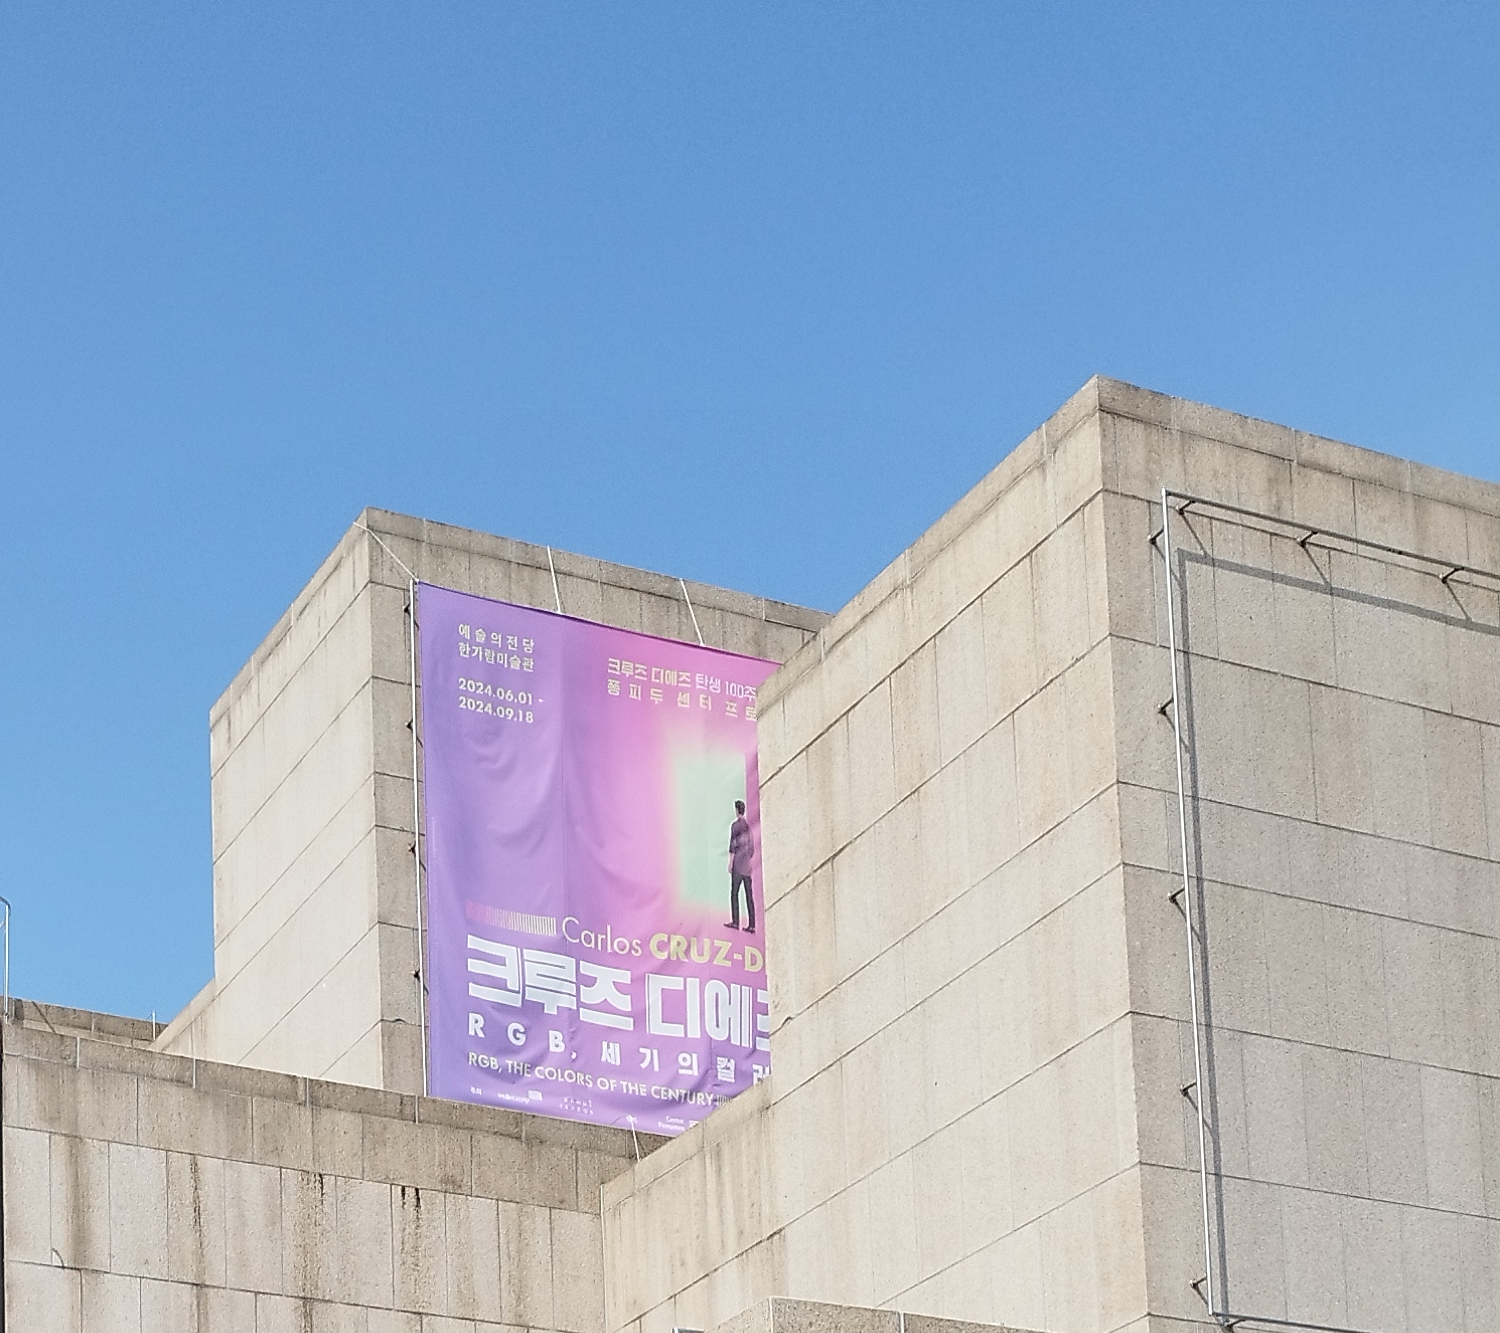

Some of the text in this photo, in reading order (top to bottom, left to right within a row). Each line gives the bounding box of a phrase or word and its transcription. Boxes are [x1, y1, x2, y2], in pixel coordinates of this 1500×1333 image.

[459, 624, 534, 653] 예술의전당
[459, 642, 534, 672] 한가람미술관
[459, 678, 533, 706] 2024.06.01
[608, 658, 647, 681] 크루즈
[651, 667, 691, 687] 디에즈
[696, 673, 721, 694] 탄생
[459, 696, 534, 724] 2024.09.18
[561, 916, 764, 973] Carlos CRUZ-D
[467, 934, 634, 1031] 크루즈
[468, 1012, 577, 1060] RGB,
[601, 1040, 699, 1077] 세기의
[468, 1052, 715, 1107] RGB, THE COLORS OF THE CENTURY
